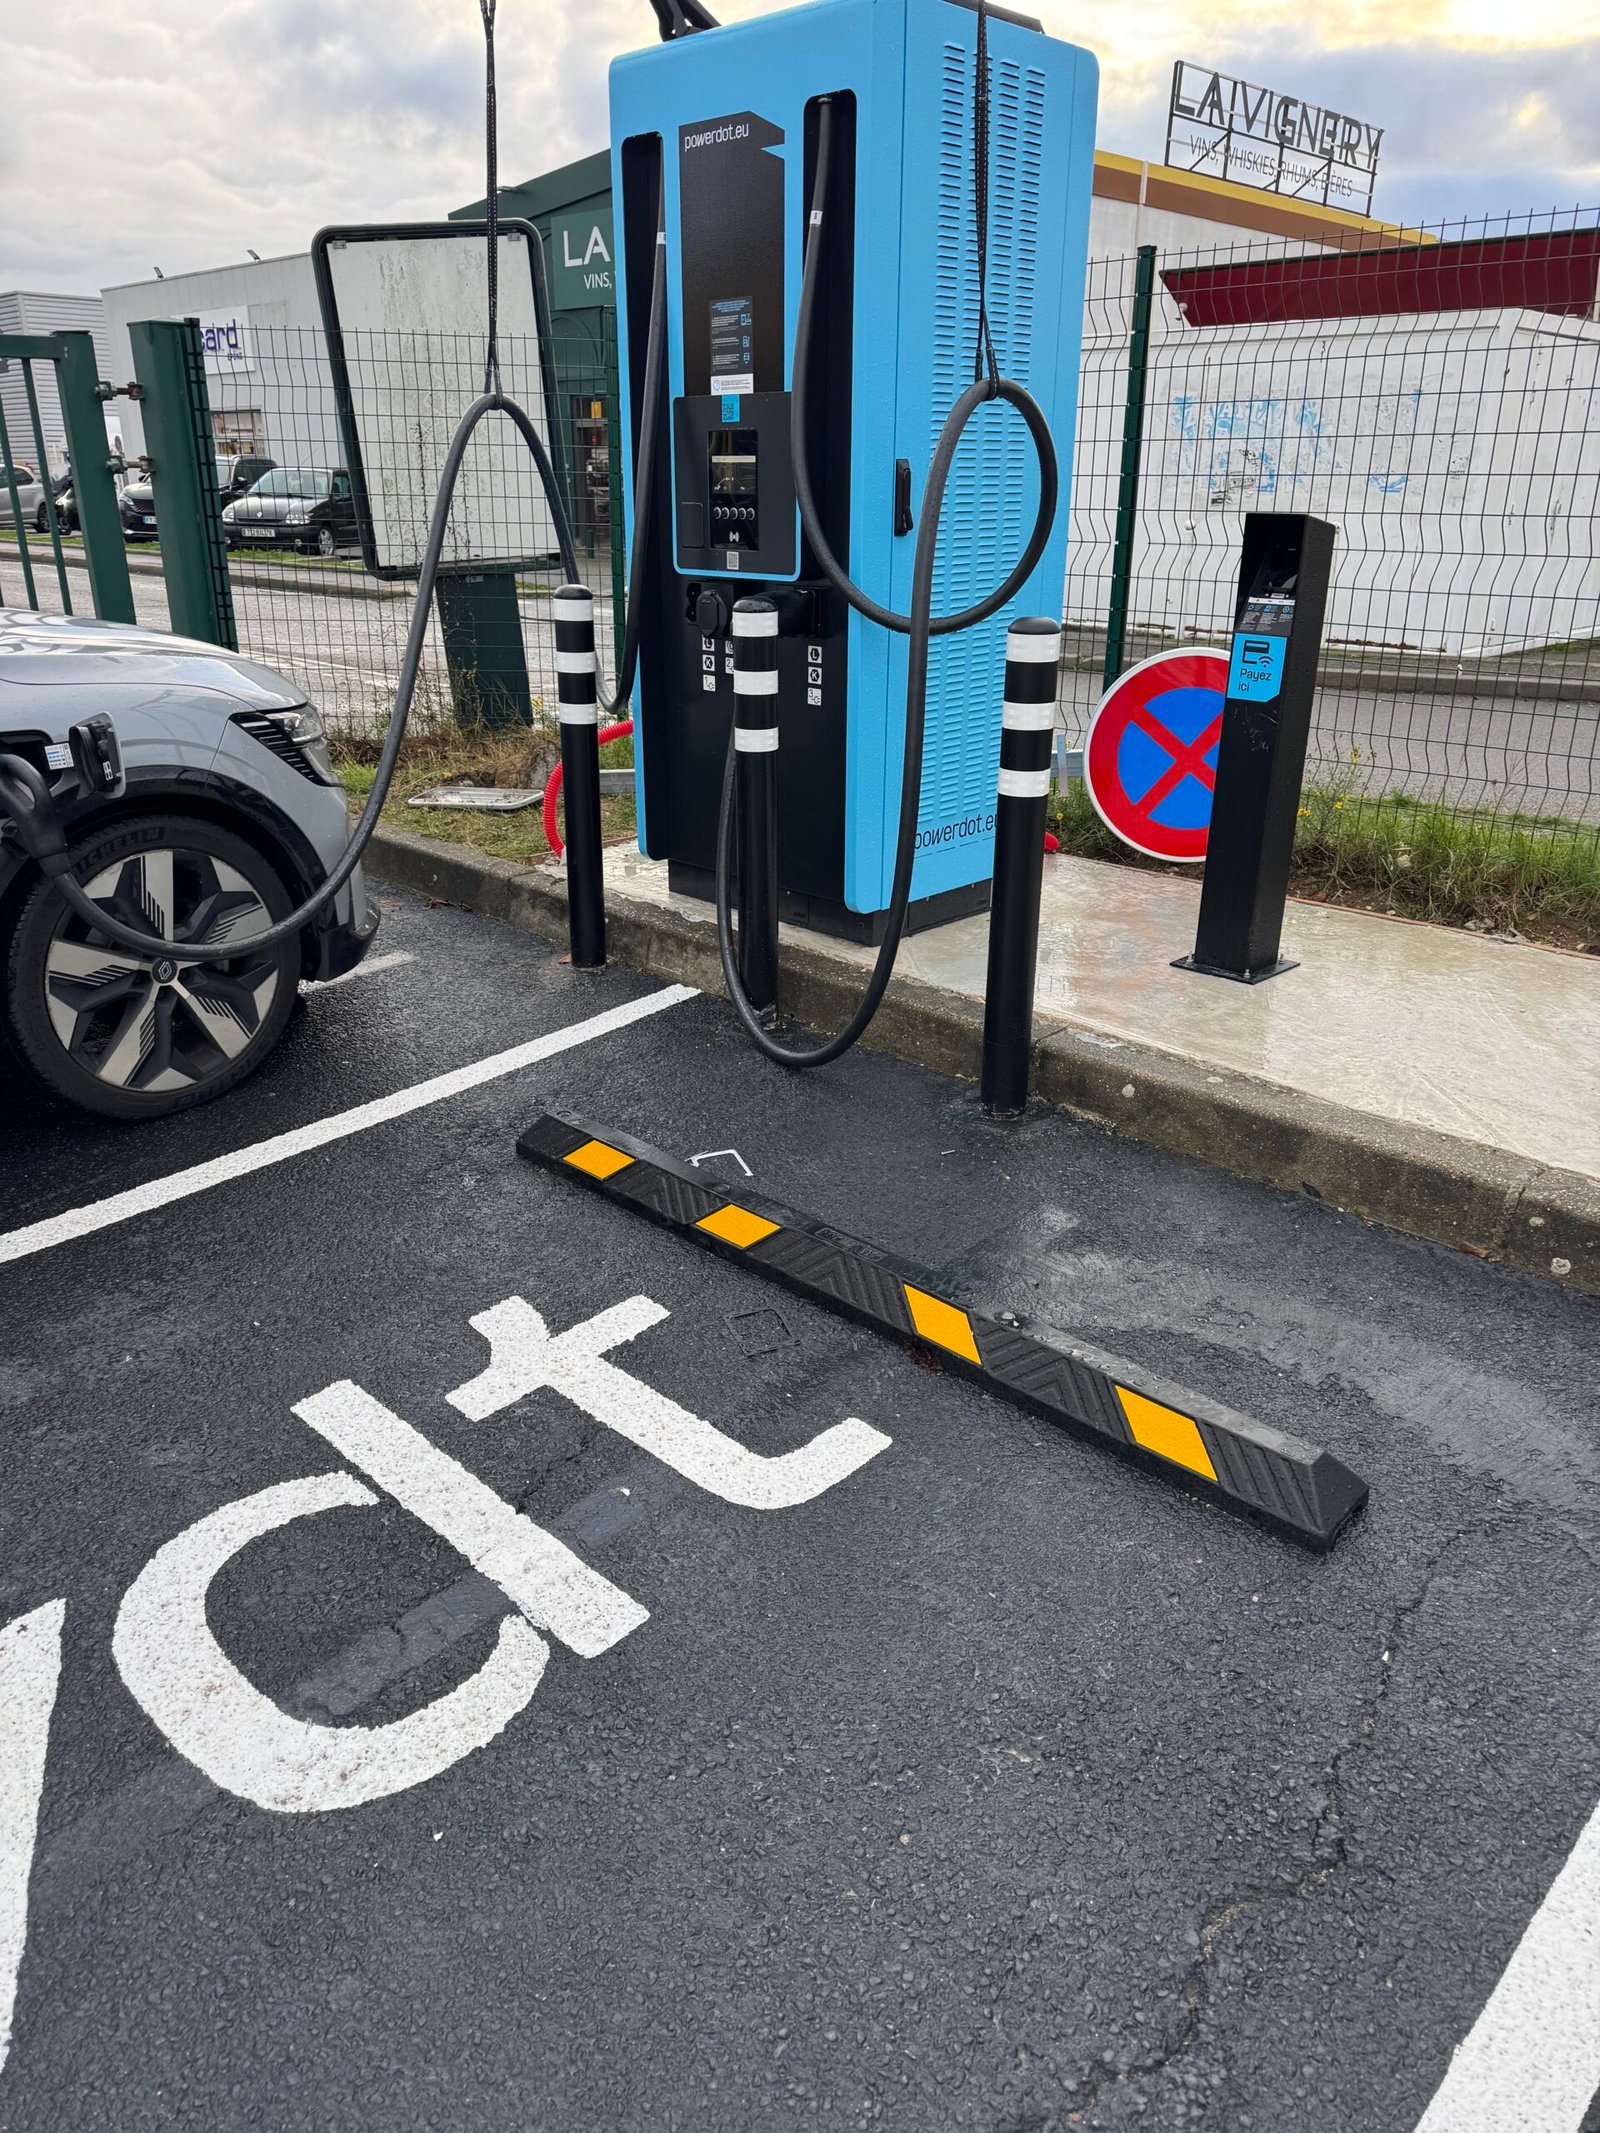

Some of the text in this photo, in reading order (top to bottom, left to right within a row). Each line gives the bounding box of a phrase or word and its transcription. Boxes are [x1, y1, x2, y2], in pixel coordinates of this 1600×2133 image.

[684, 123, 749, 152] powerdot.eu
[1190, 134, 1219, 165] VINS,
[1321, 169, 1353, 197] BÈRES
[563, 225, 611, 268] LA
[583, 272, 613, 289] VINS,
[1237, 680, 1250, 692] ici
[1239, 668, 1272, 683] Payez
[915, 813, 998, 850] powerdot.e
